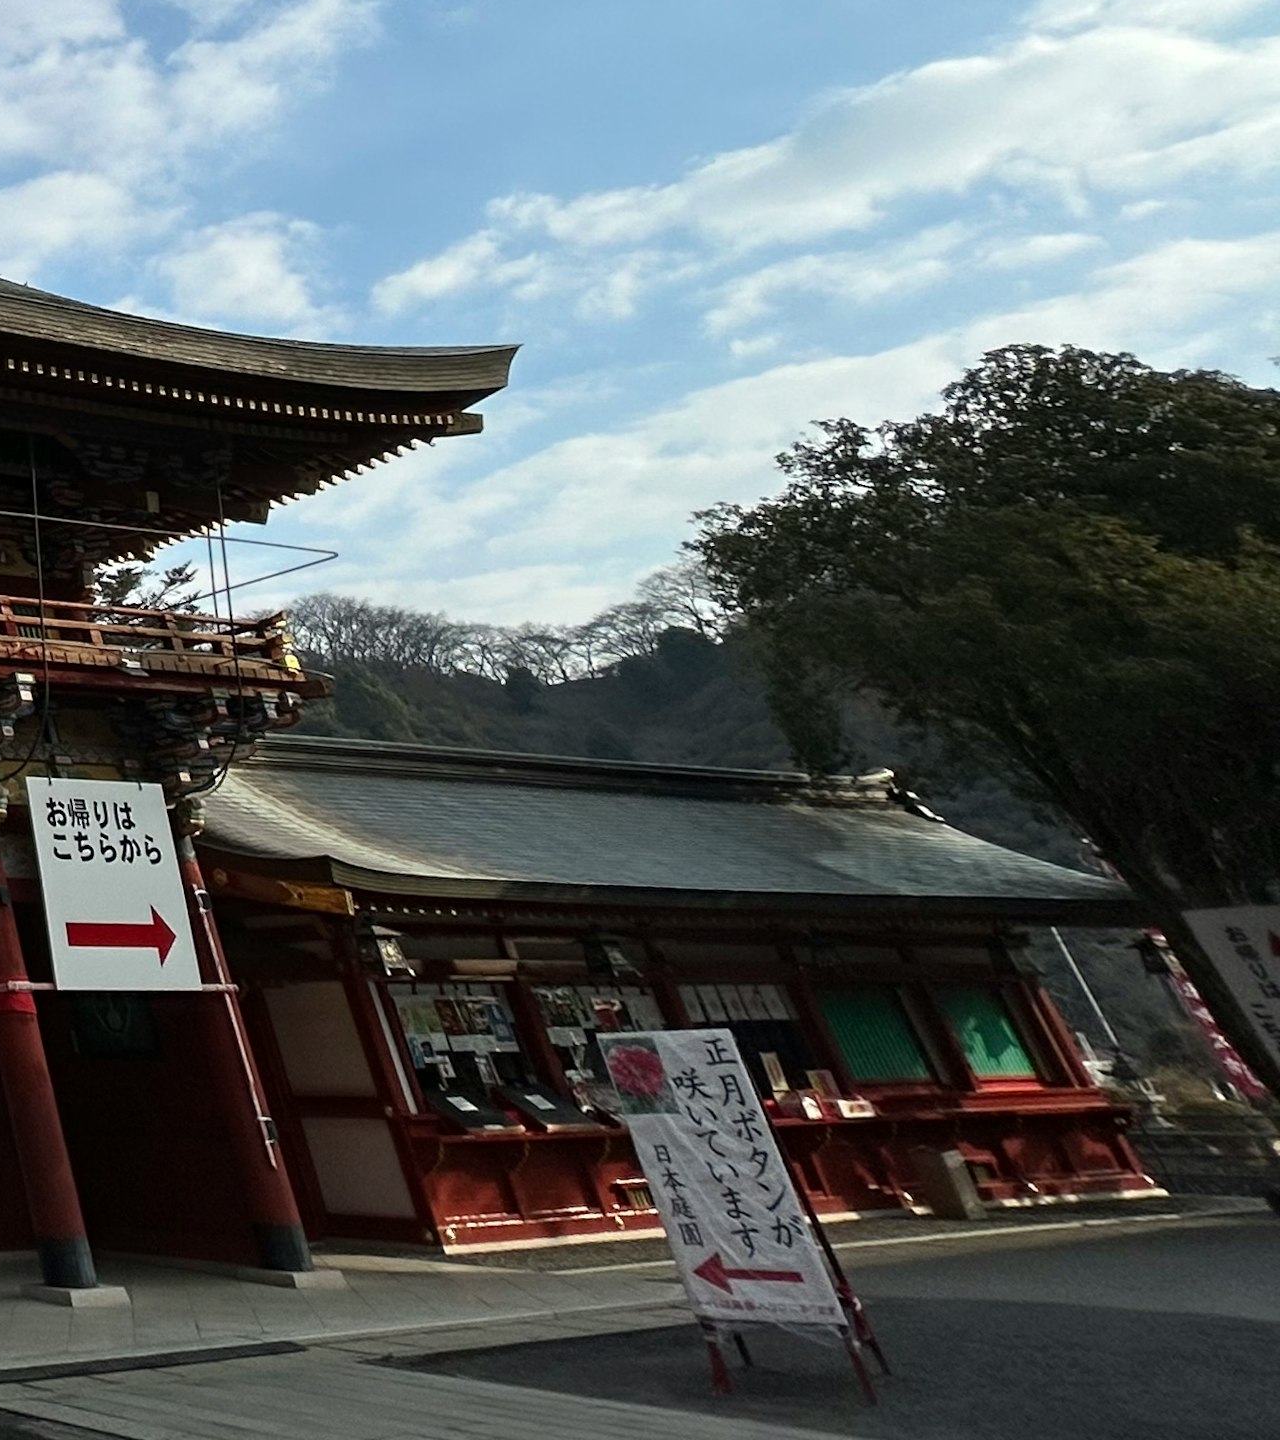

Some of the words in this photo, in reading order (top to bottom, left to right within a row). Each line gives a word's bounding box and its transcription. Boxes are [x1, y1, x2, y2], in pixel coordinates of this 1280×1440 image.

[46, 797, 136, 830] お帰りは
[53, 832, 162, 864] こちらから
[673, 1067, 759, 1258] 咲いています
[703, 1037, 804, 1248] 正月ボタンが
[653, 1144, 704, 1248] 日本庭園
